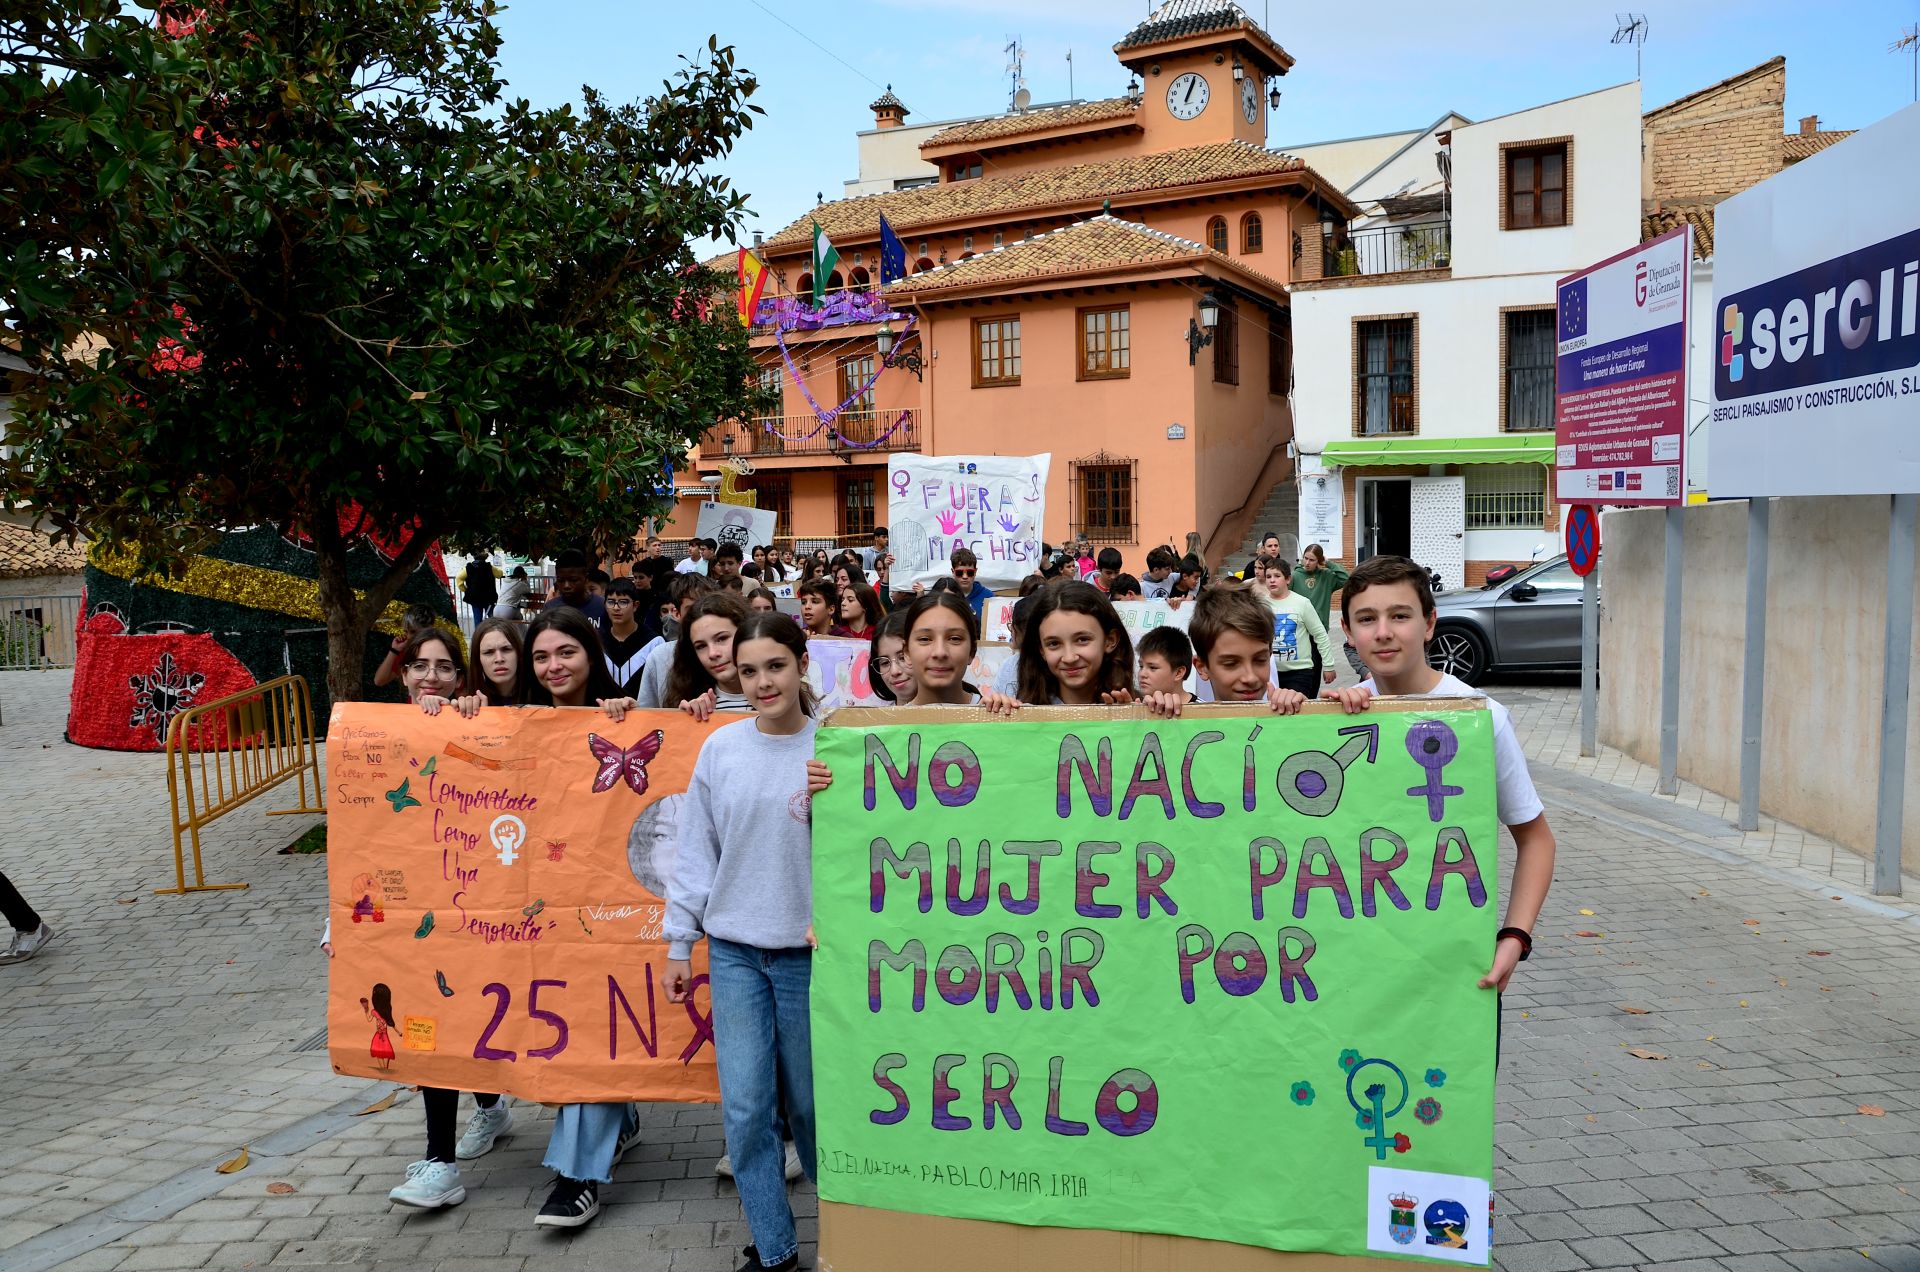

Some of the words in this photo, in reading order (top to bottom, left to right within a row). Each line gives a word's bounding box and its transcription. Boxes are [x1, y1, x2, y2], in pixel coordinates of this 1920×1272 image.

[1648, 284, 1656, 298] de
[1656, 277, 1680, 296] Granada
[1649, 260, 1681, 283] Diputación
[1749, 260, 1919, 370] sercli
[1592, 354, 1606, 366] Europeo
[1612, 346, 1632, 359] Desarrollo
[1632, 342, 1649, 356] Regional
[1592, 366, 1608, 378] manera
[1616, 361, 1628, 374] hacer
[1628, 358, 1646, 373] Europa
[1713, 406, 1741, 422] SERCLI
[1742, 397, 1794, 418] PAISAJISMO
[1796, 394, 1804, 410] Y
[1805, 377, 1897, 410] CONSTRUCCIÓN,
[919, 478, 1018, 513] FUERA
[967, 511, 994, 535] EL
[366, 753, 382, 764] NO
[863, 732, 982, 812] NO
[1056, 723, 1263, 821] NACÍ
[433, 808, 482, 852] Como
[443, 848, 479, 890] Una
[869, 836, 1178, 918] MUJER
[1249, 826, 1488, 920] PARA
[1175, 923, 1319, 1004] POR
[472, 978, 570, 1063] 25
[606, 961, 659, 1061] N
